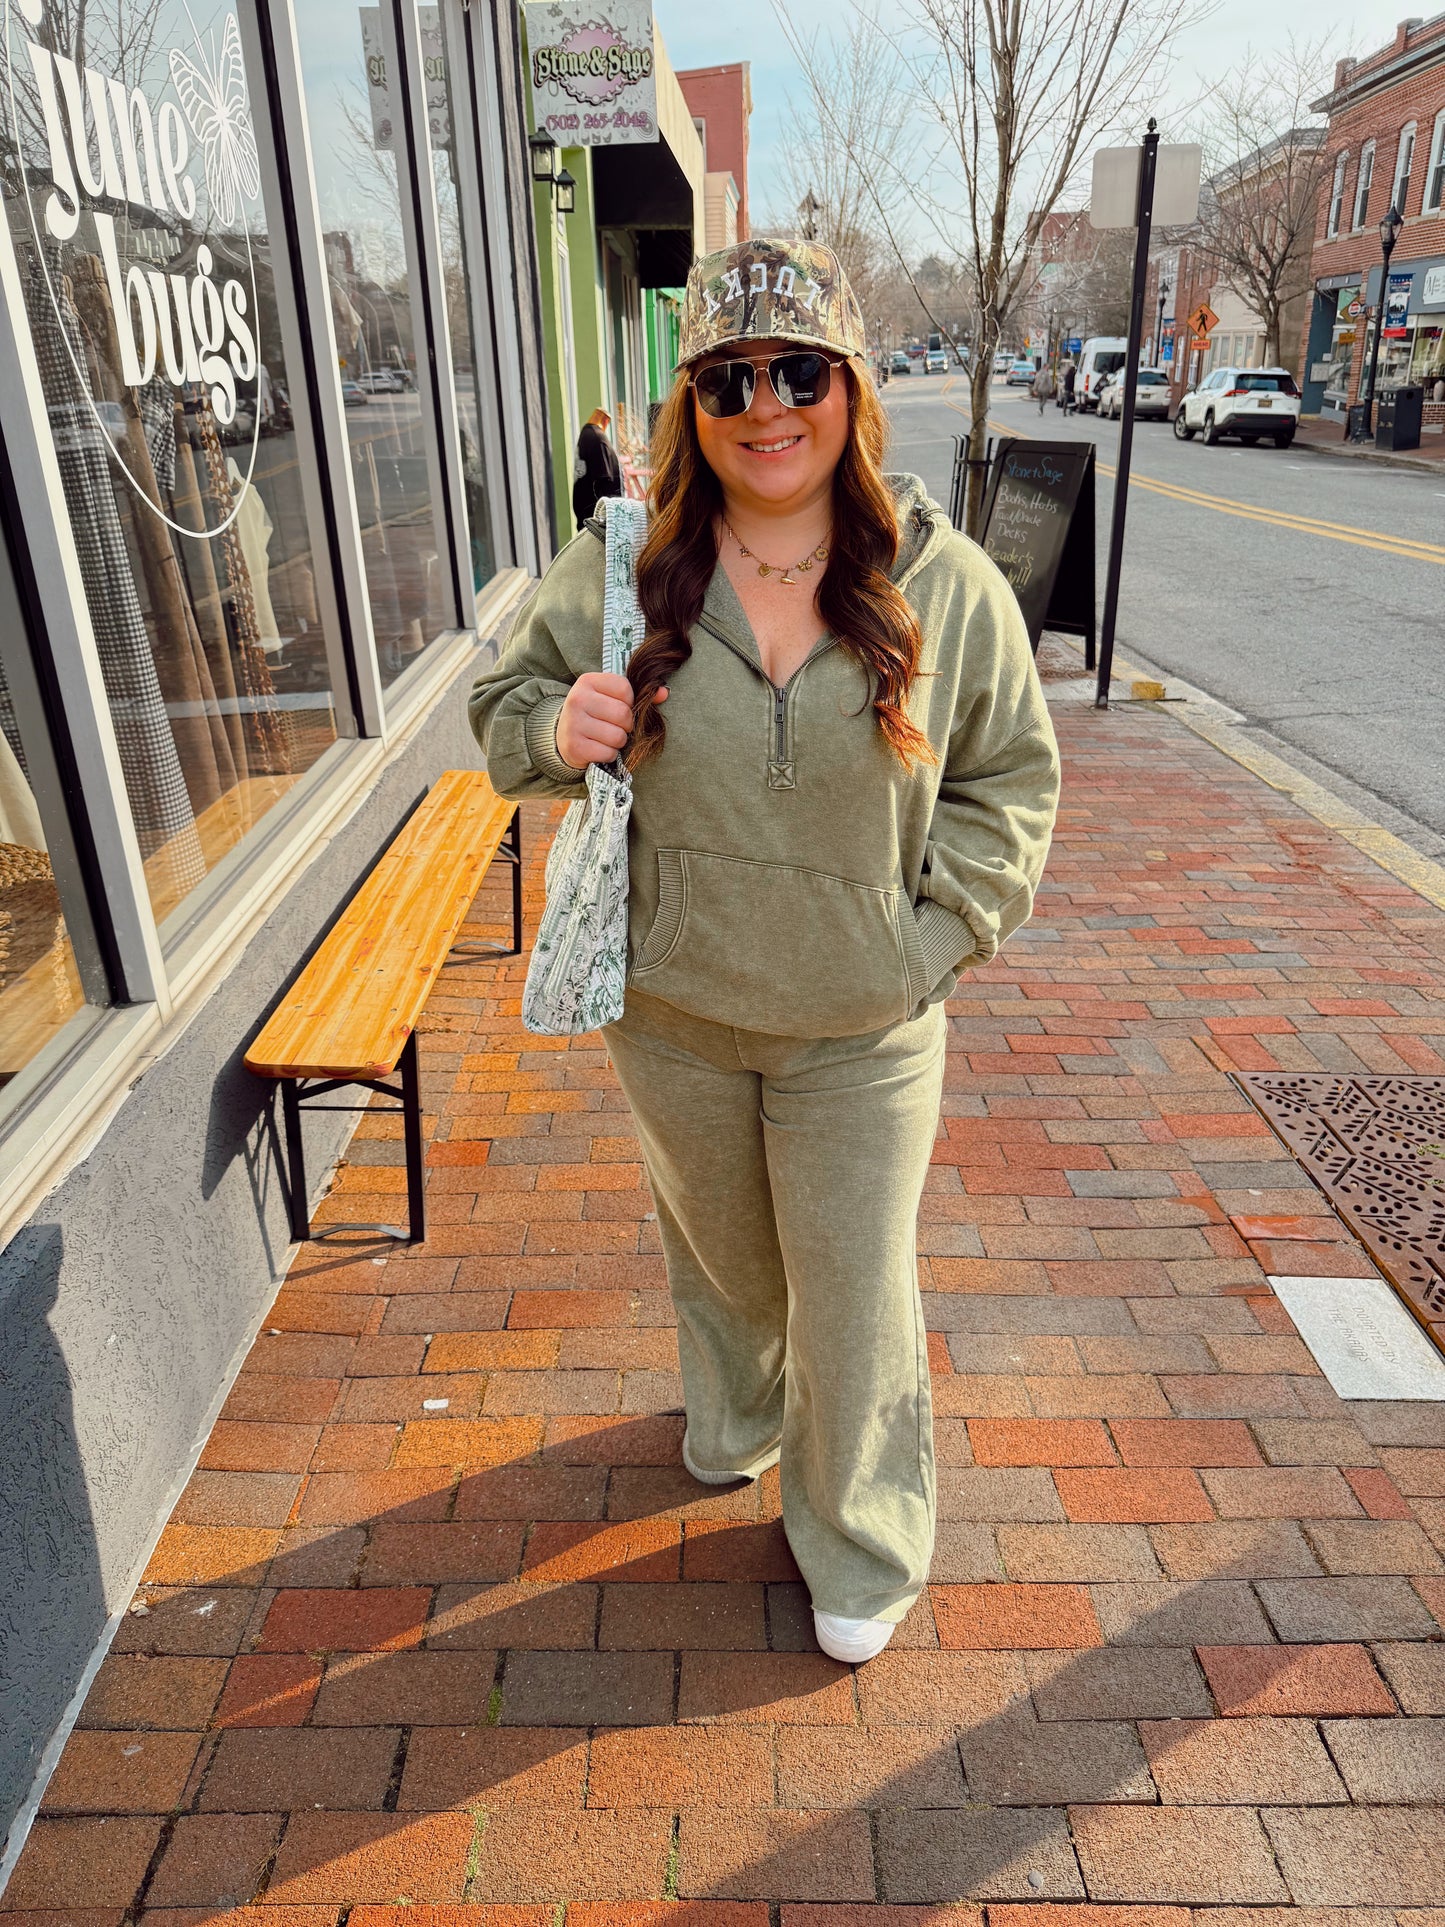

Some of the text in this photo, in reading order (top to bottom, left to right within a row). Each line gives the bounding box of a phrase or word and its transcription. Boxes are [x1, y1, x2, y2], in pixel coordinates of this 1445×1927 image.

[537, 45, 651, 82] Stone & Sage
[19, 0, 196, 241] june
[703, 263, 821, 316] LUCKY
[93, 212, 256, 425] bugs
[1030, 492, 1058, 514] Herbs
[998, 523, 1028, 544] Decks
